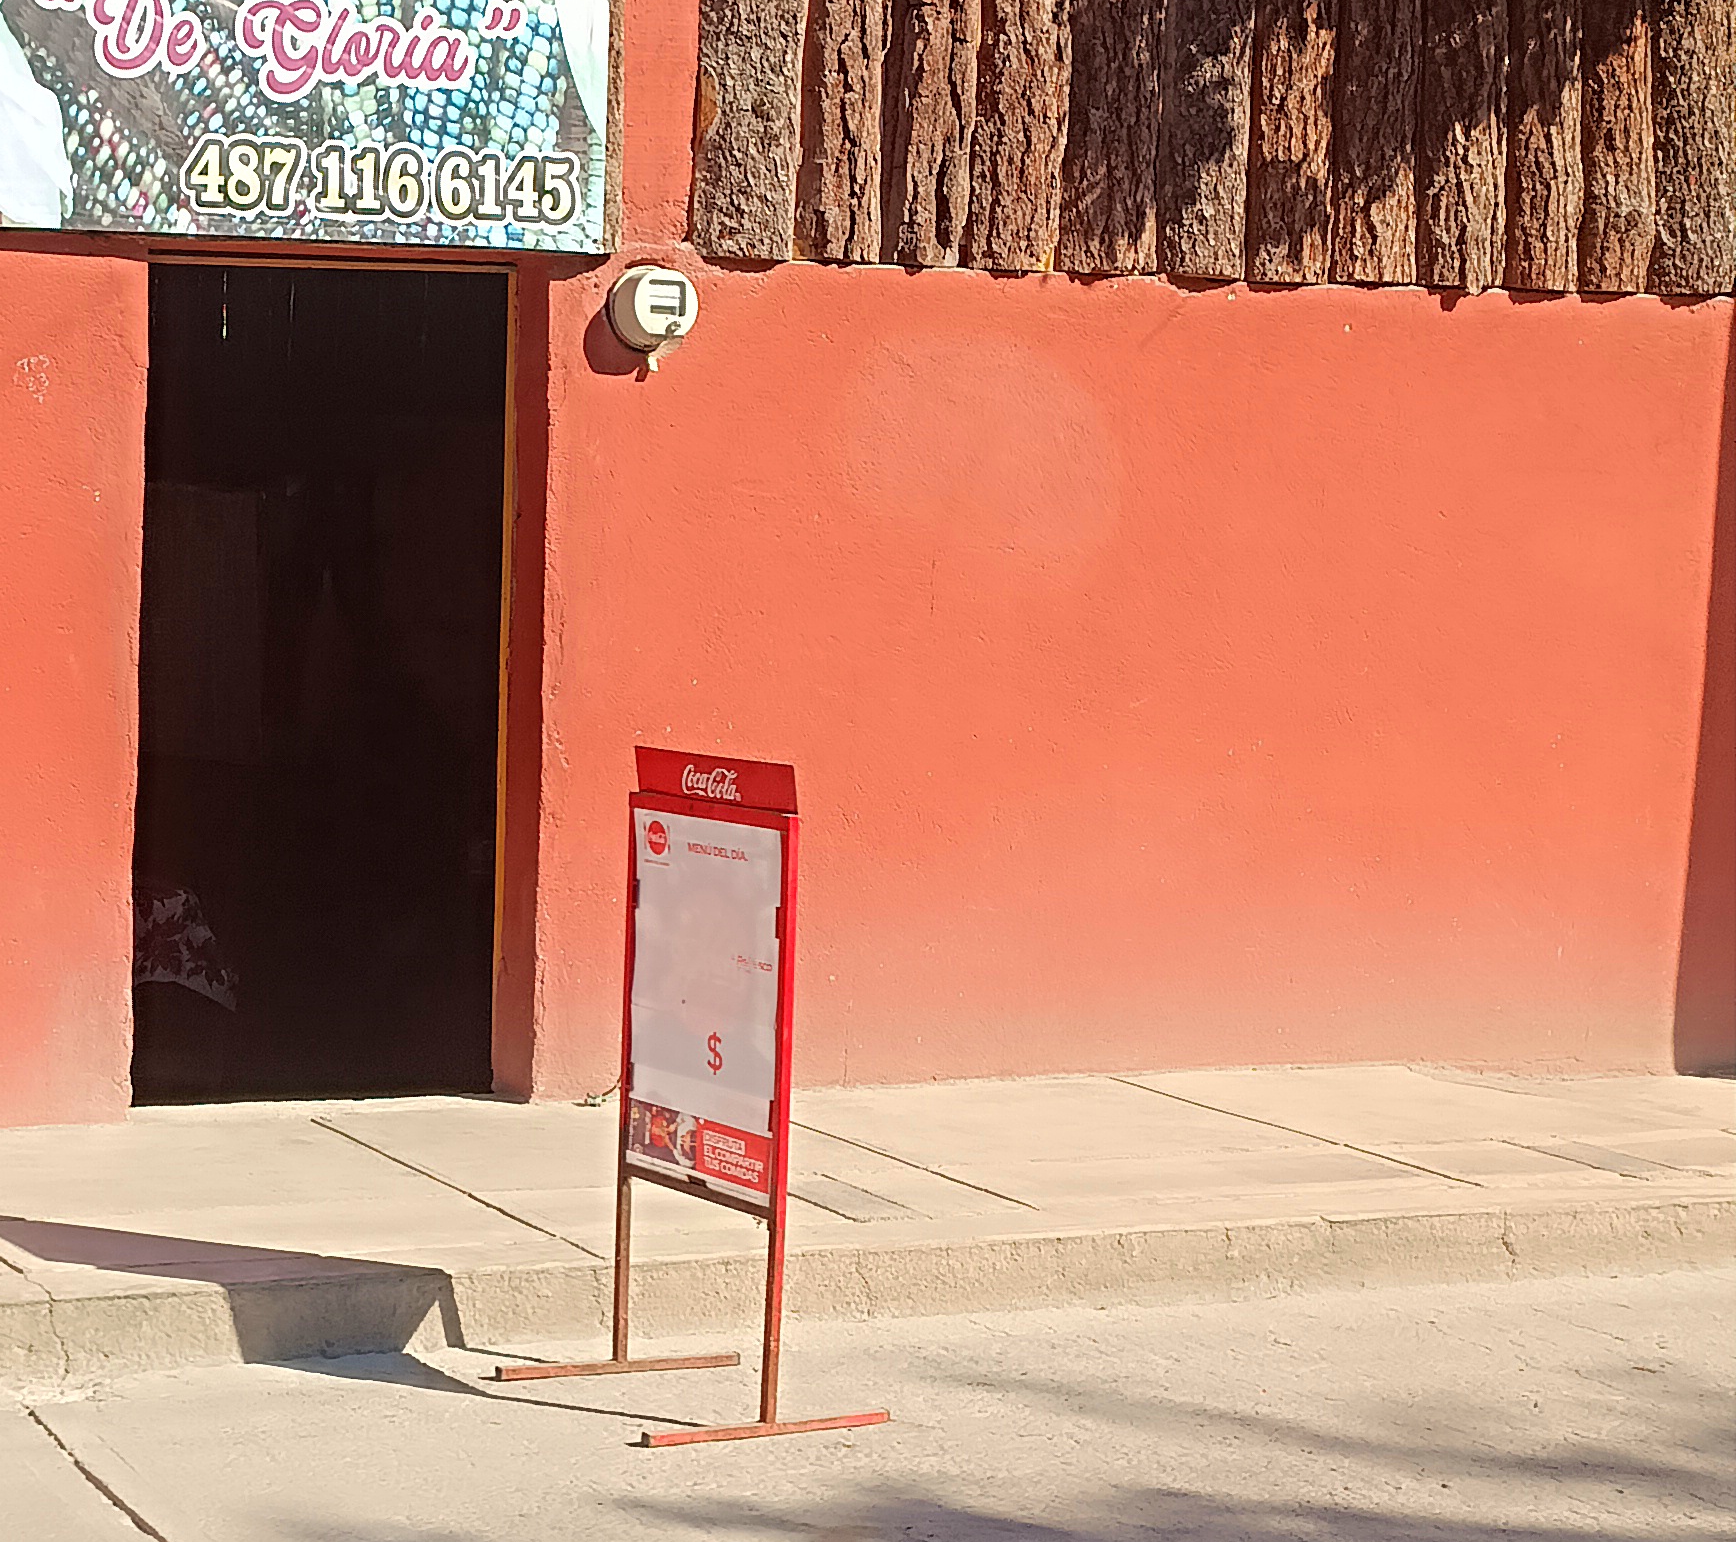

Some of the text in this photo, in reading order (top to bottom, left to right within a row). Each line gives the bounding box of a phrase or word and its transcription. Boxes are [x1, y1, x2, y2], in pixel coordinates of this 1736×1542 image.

[186, 140, 578, 222] 487 116 6145
[707, 1032, 723, 1075] $
